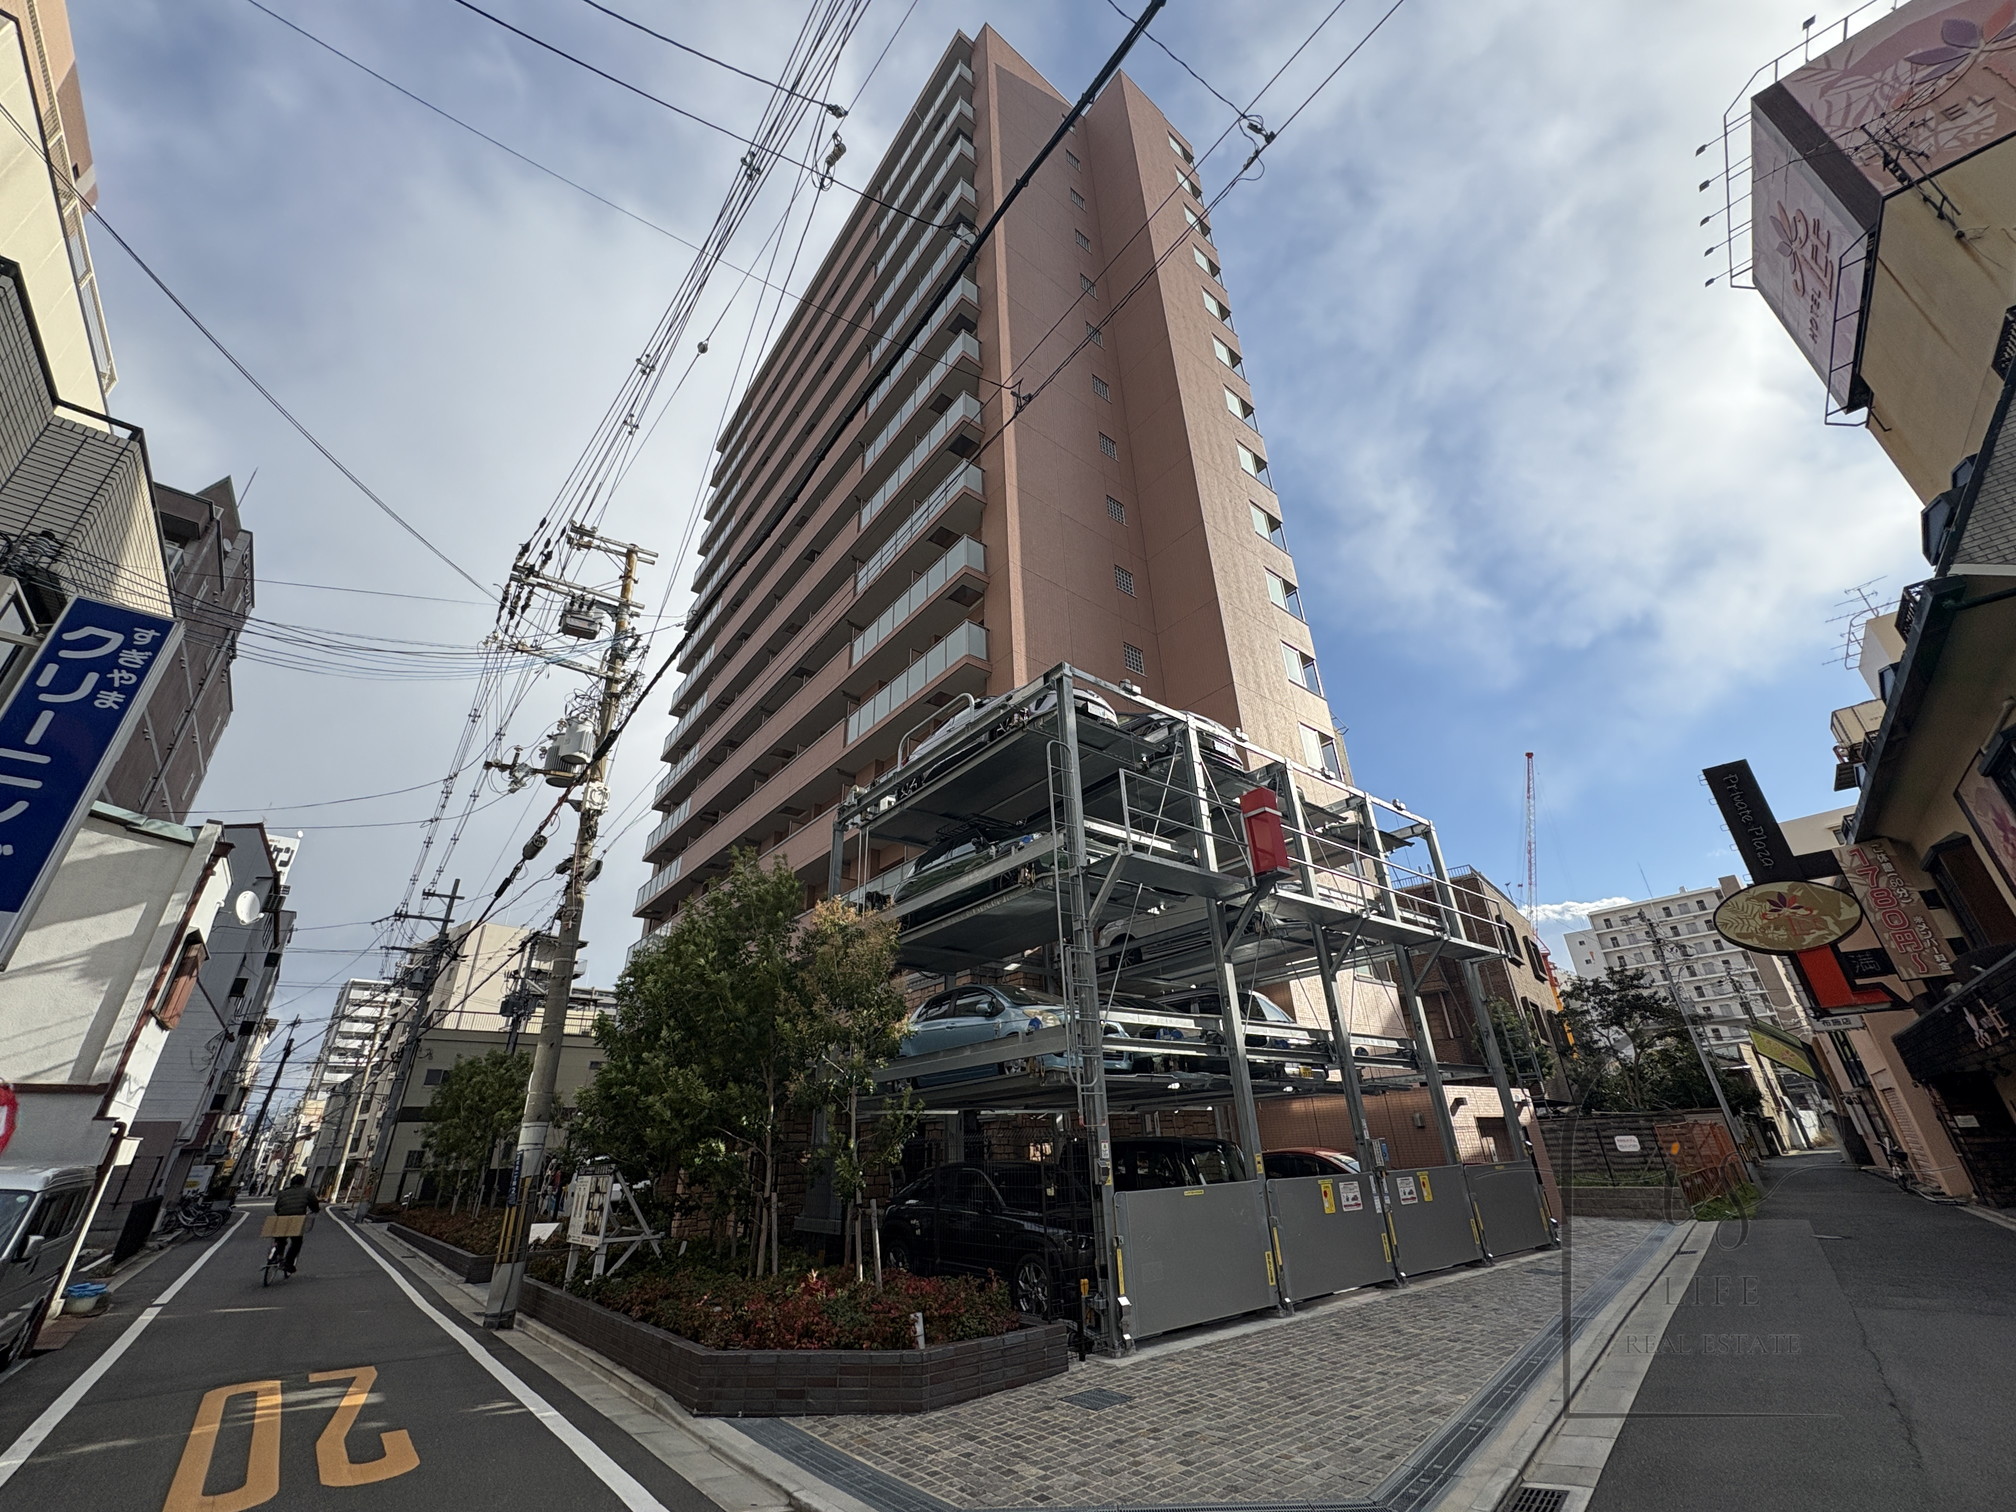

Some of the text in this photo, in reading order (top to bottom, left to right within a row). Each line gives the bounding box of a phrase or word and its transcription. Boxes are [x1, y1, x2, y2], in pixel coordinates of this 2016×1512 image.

[1808, 288, 1823, 344] HOTEL
[93, 627, 161, 710] すぎやま
[1722, 773, 1775, 867] Private Plaza
